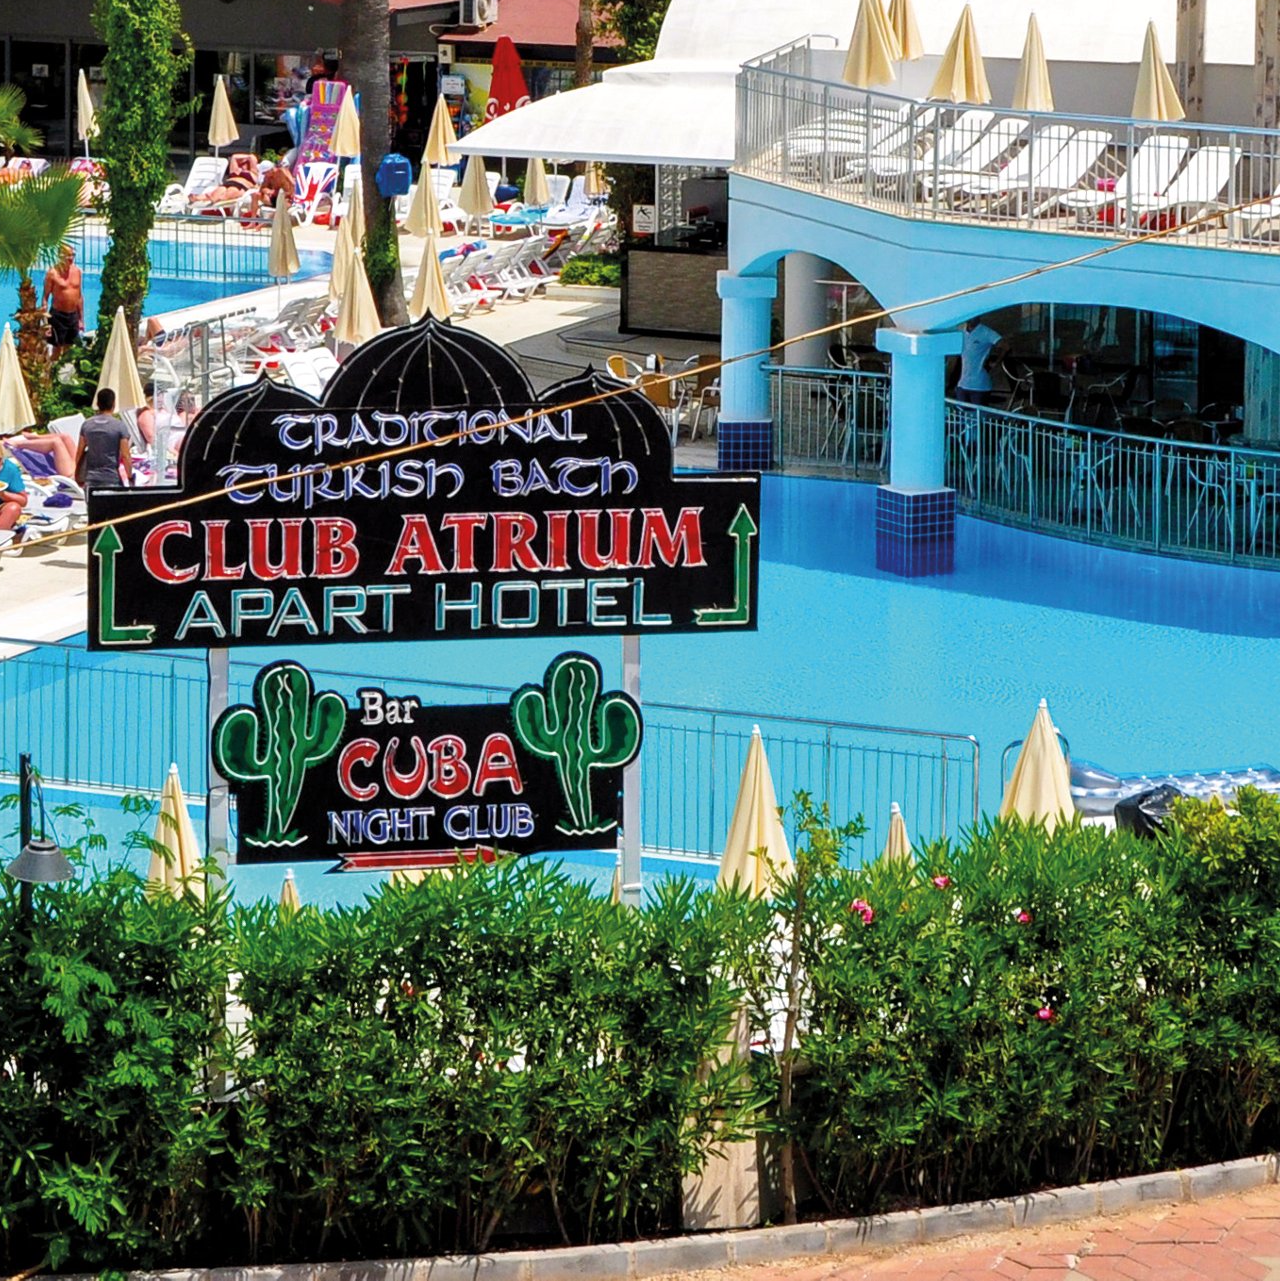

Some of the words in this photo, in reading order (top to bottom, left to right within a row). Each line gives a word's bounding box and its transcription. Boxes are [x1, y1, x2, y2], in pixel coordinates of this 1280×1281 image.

[271, 409, 587, 453] TRADITIONAL
[141, 518, 361, 584] CLUB
[384, 505, 706, 577] ATRIUM
[174, 583, 411, 640] APART
[434, 576, 671, 631] HOTEL
[361, 691, 419, 726] Bar
[337, 734, 523, 801] CUBA
[327, 807, 435, 845] NIGHT
[444, 803, 535, 840] CLUB
